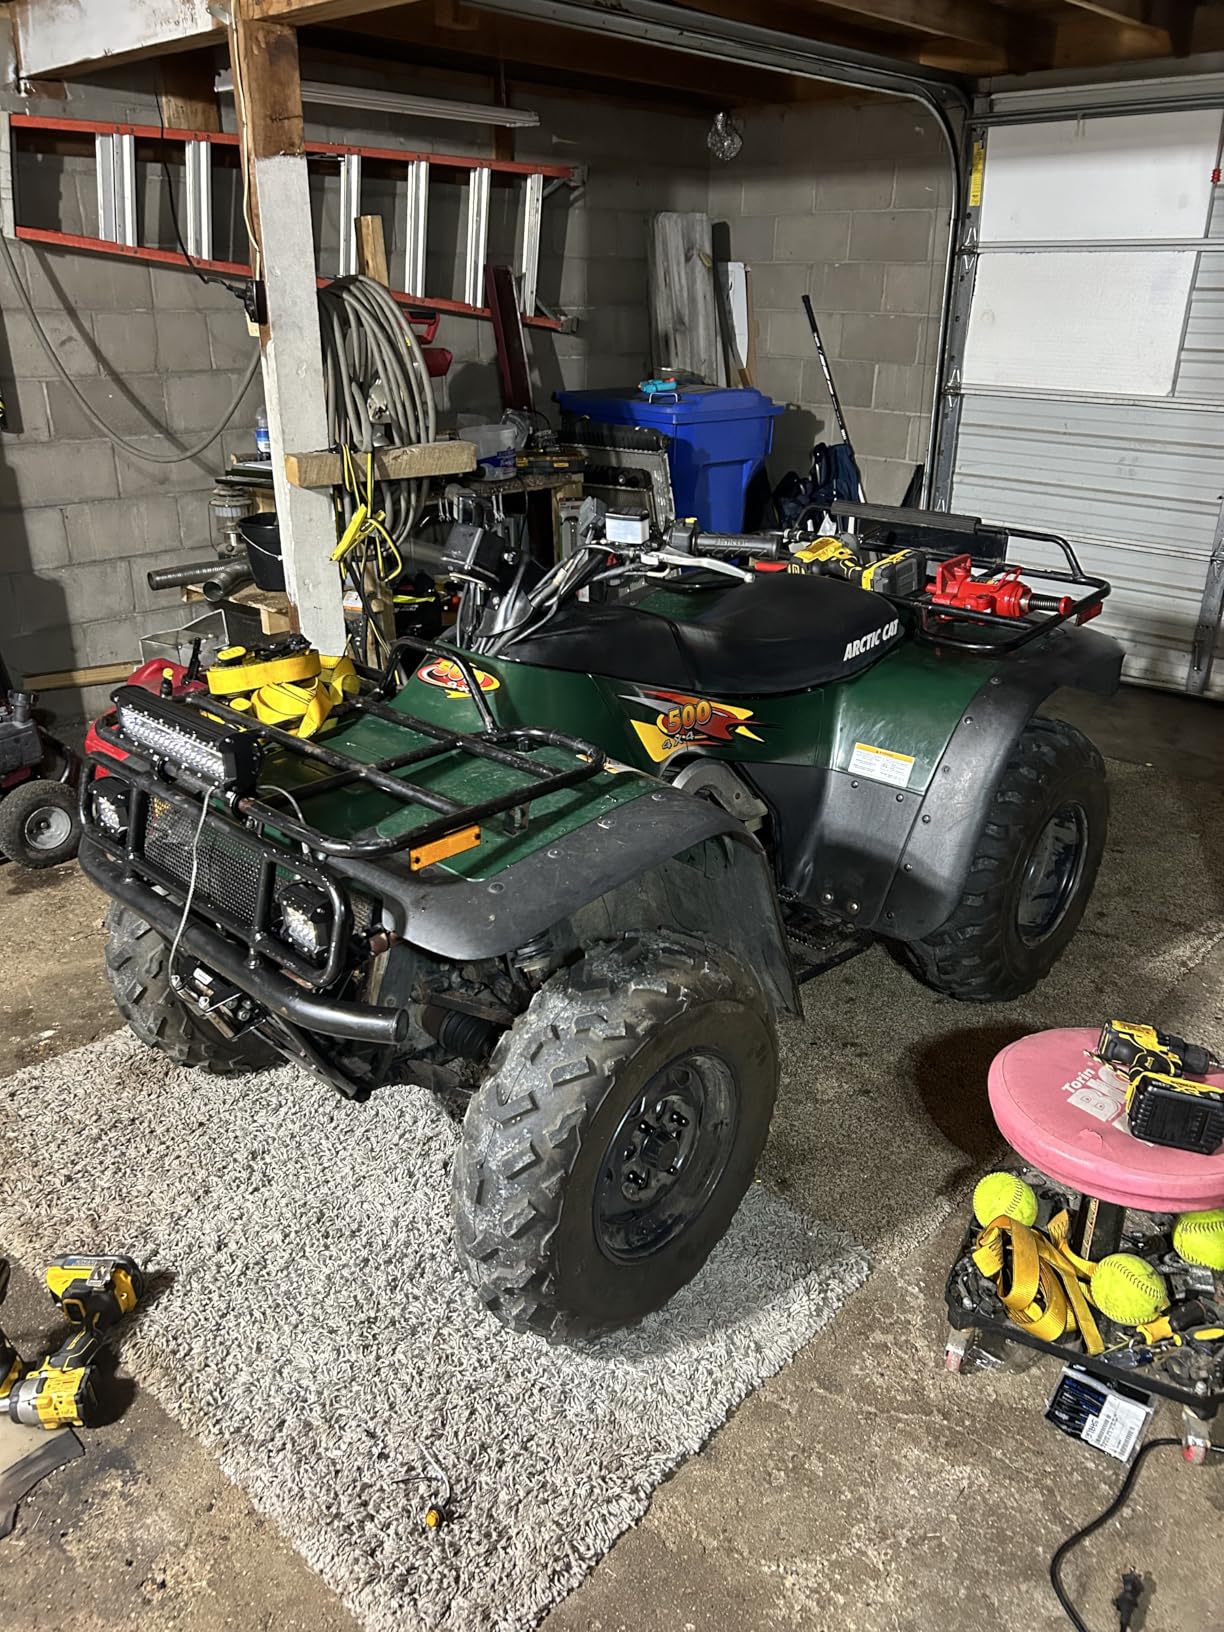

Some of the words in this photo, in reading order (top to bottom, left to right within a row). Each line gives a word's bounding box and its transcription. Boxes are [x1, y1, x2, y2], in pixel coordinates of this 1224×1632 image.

[843, 628, 881, 661] ARCTIC
[882, 618, 898, 641] CAT
[667, 700, 712, 735] 500
[1061, 1066, 1096, 1093] Torin
